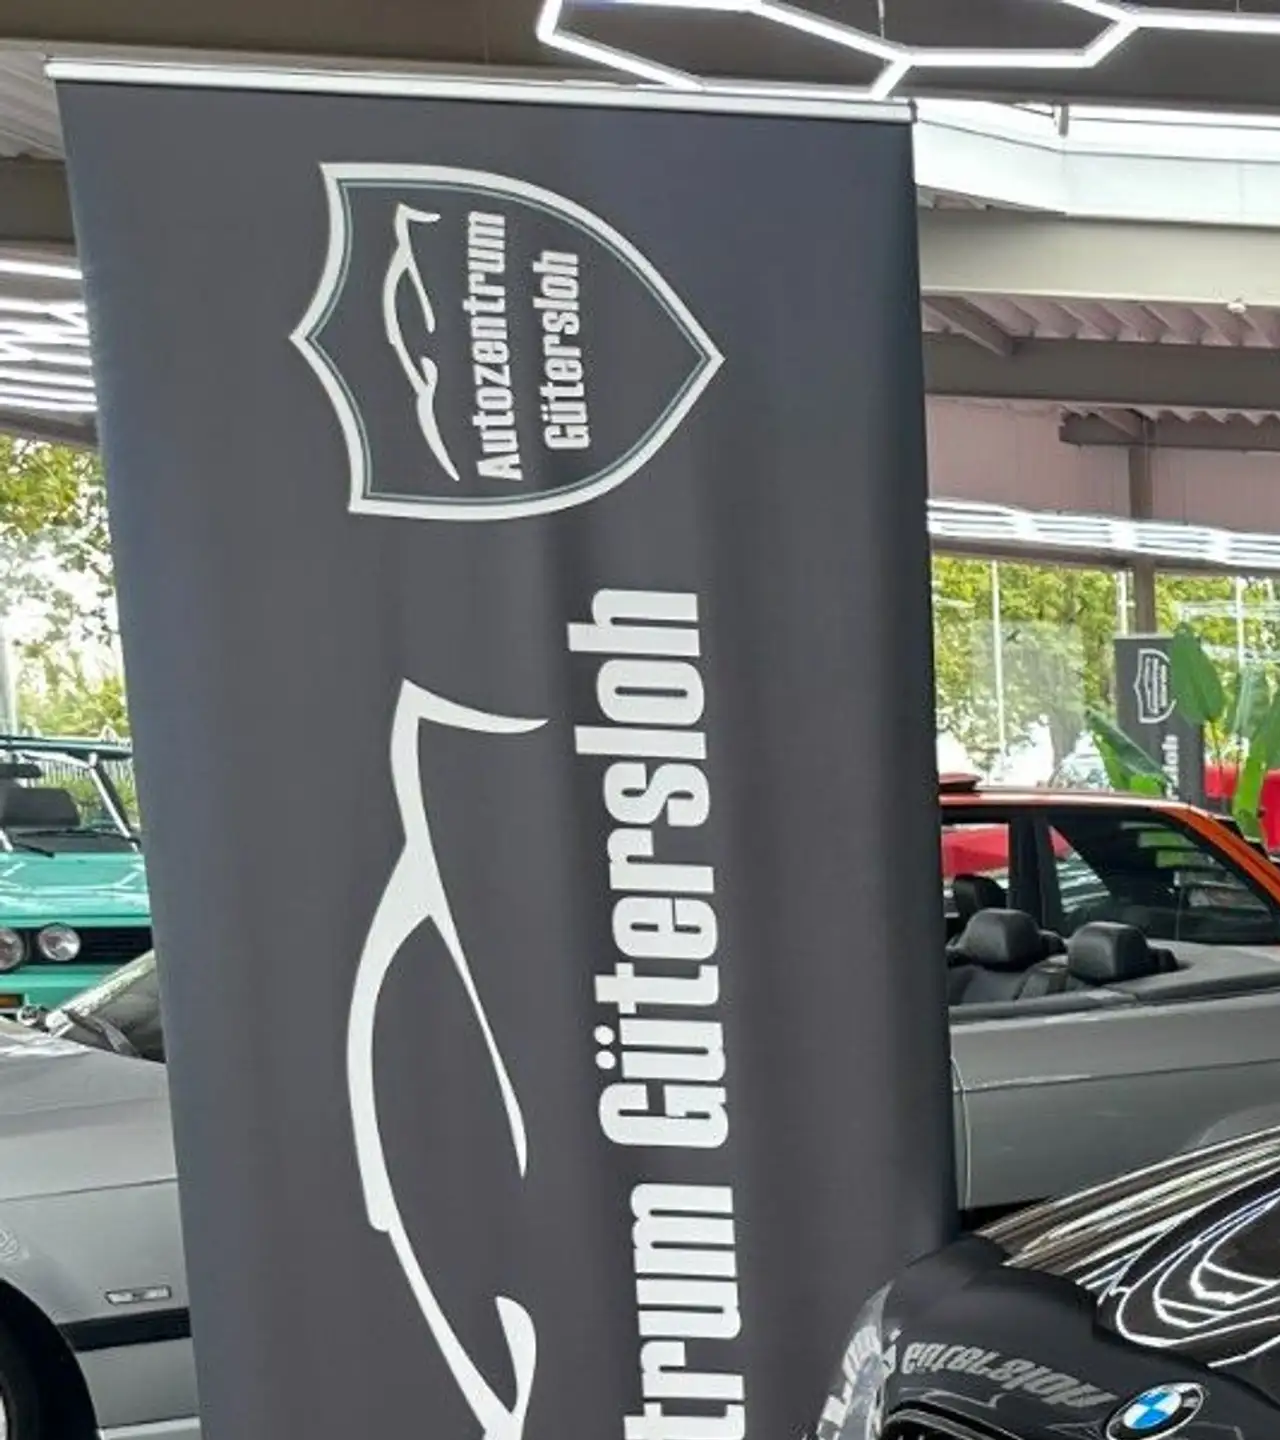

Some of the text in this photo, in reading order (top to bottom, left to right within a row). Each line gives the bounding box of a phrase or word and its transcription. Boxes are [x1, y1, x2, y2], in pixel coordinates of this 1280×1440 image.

[464, 210, 523, 481] Autozentrum
[532, 250, 591, 451] Gütersloh
[567, 587, 733, 1149] Gütersloh
